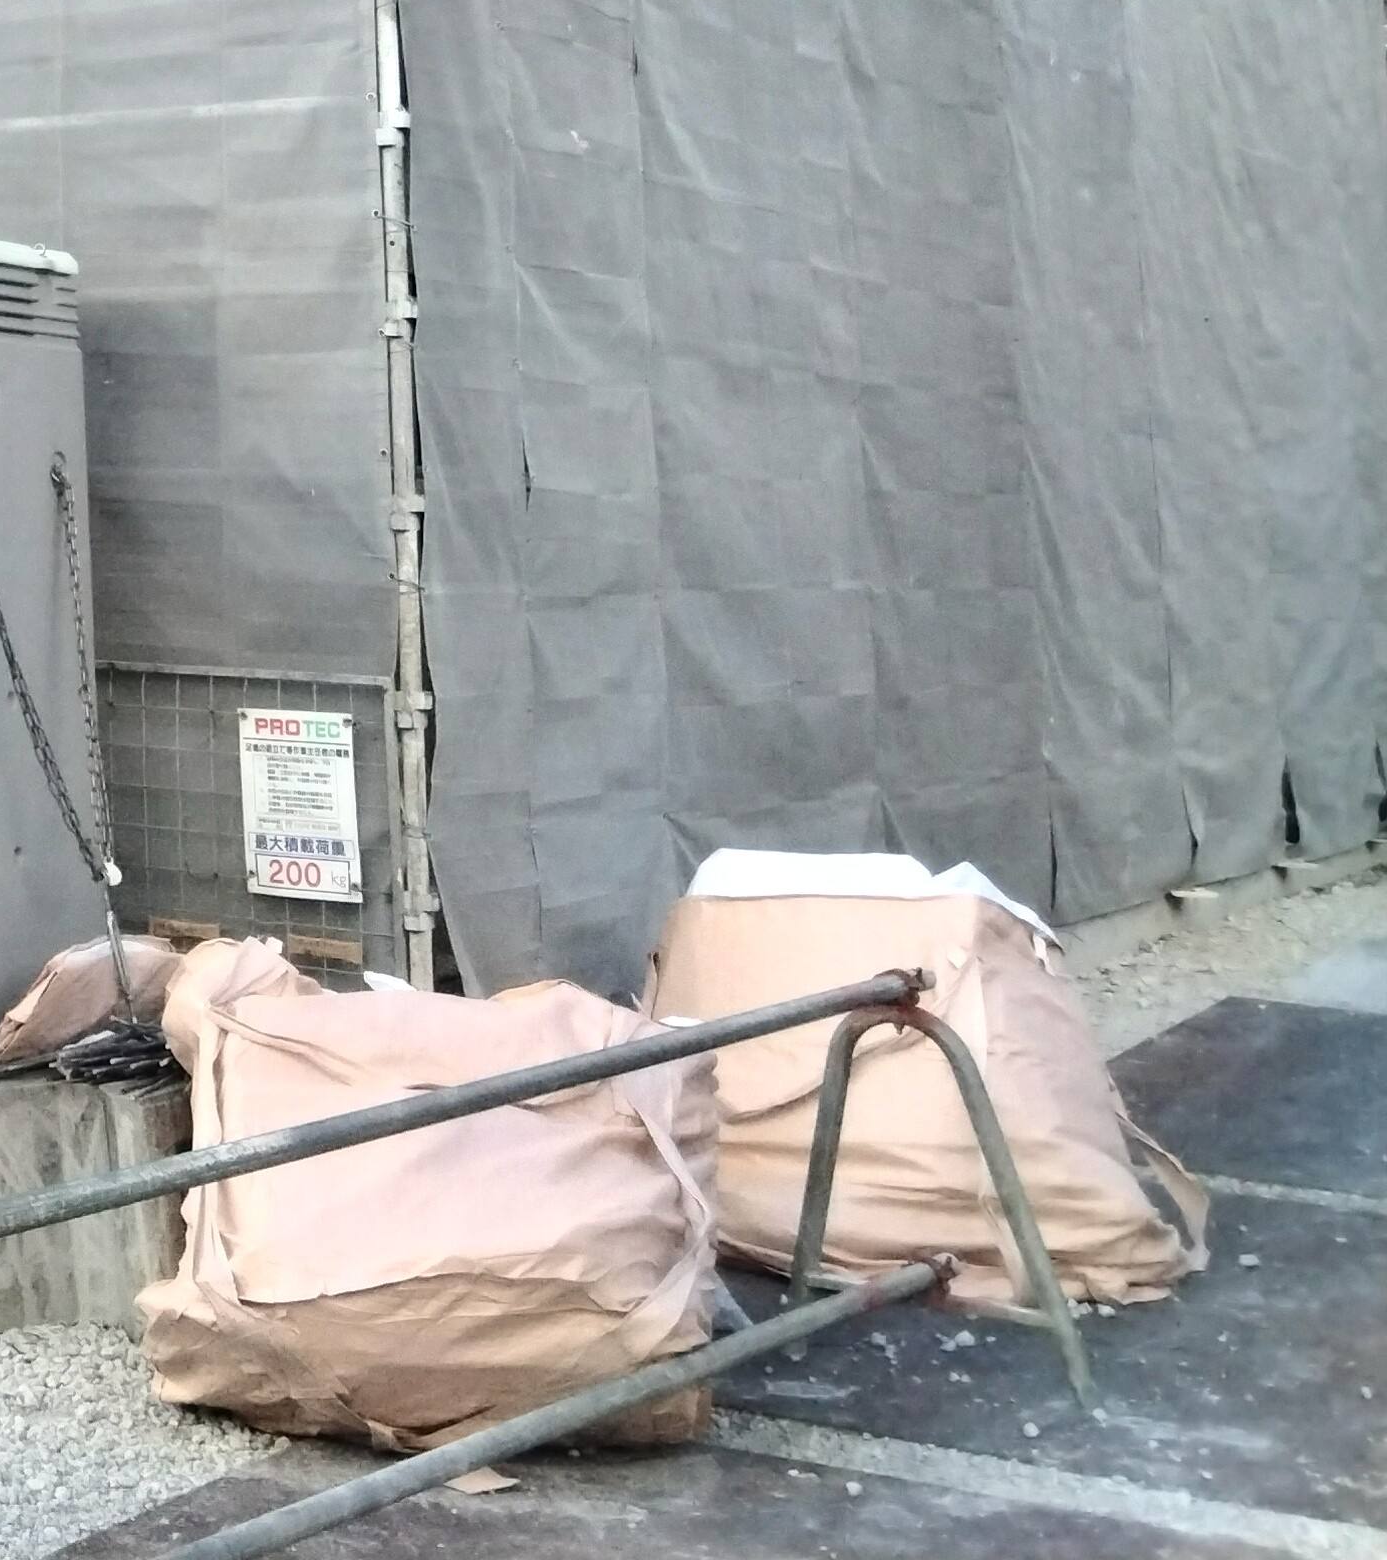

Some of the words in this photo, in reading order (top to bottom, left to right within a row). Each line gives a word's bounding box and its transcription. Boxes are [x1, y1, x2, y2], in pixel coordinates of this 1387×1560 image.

[254, 717, 341, 739] PROTEC
[255, 834, 346, 856] 最大積載荷重
[269, 859, 321, 889] 200
